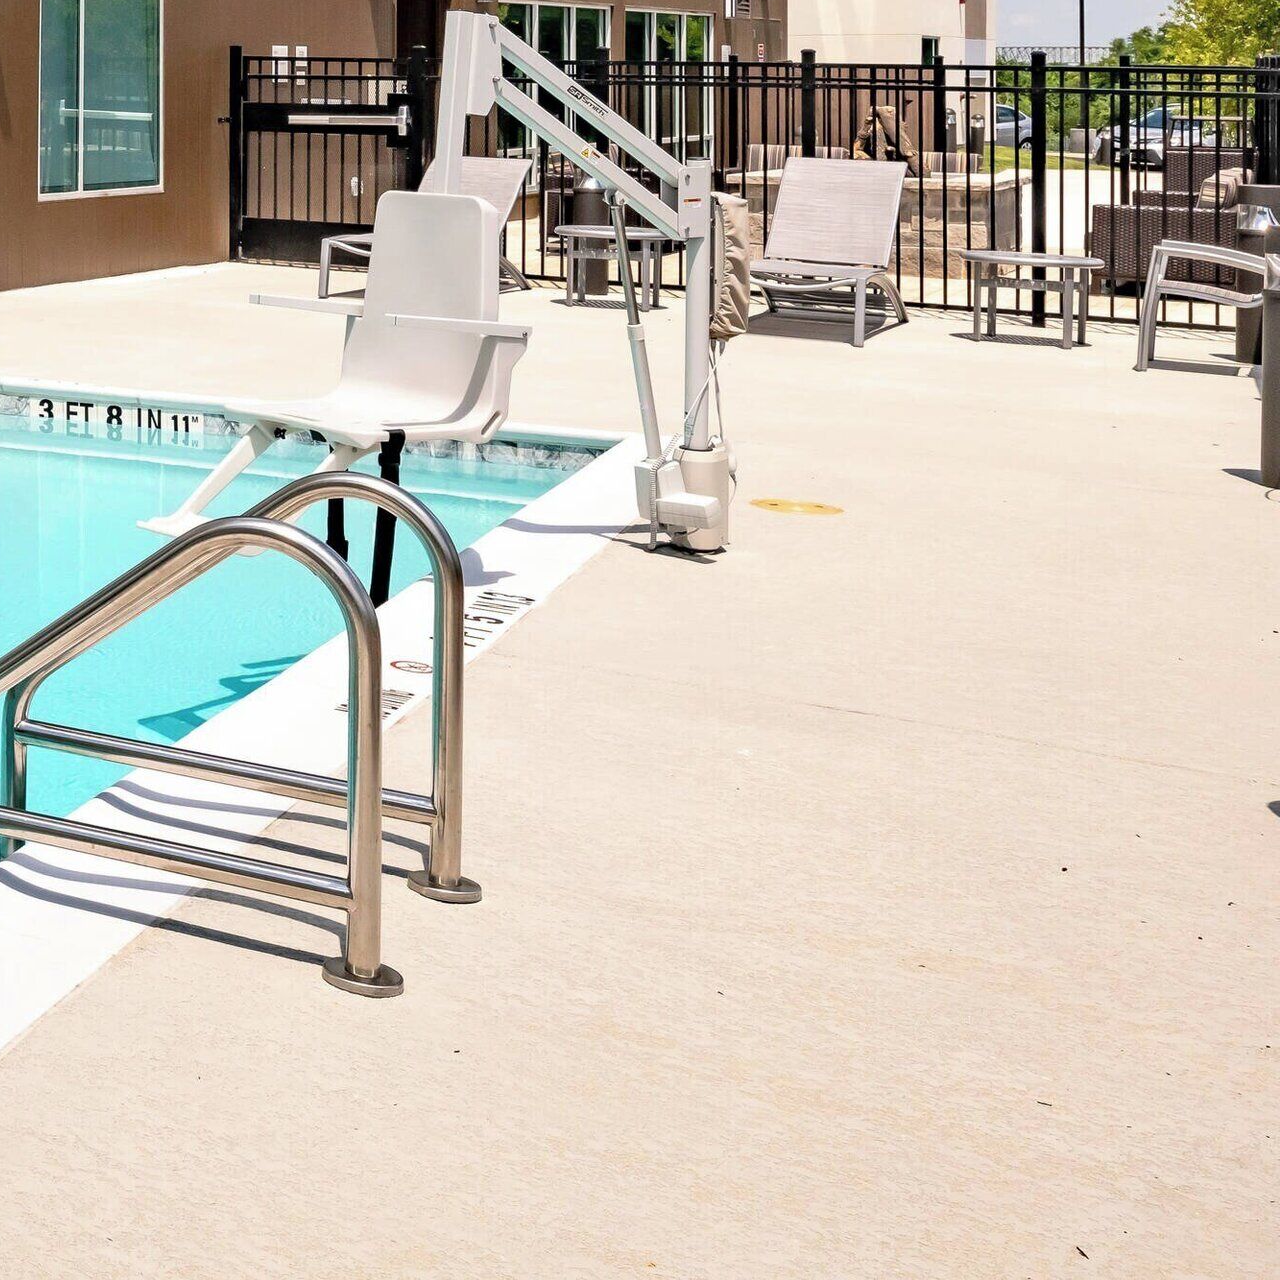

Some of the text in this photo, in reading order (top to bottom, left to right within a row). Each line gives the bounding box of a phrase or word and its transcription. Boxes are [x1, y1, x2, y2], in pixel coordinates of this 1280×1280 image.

[39, 398, 54, 419] 3
[66, 401, 94, 423] FT
[107, 405, 122, 426] 8
[137, 407, 161, 430] IN
